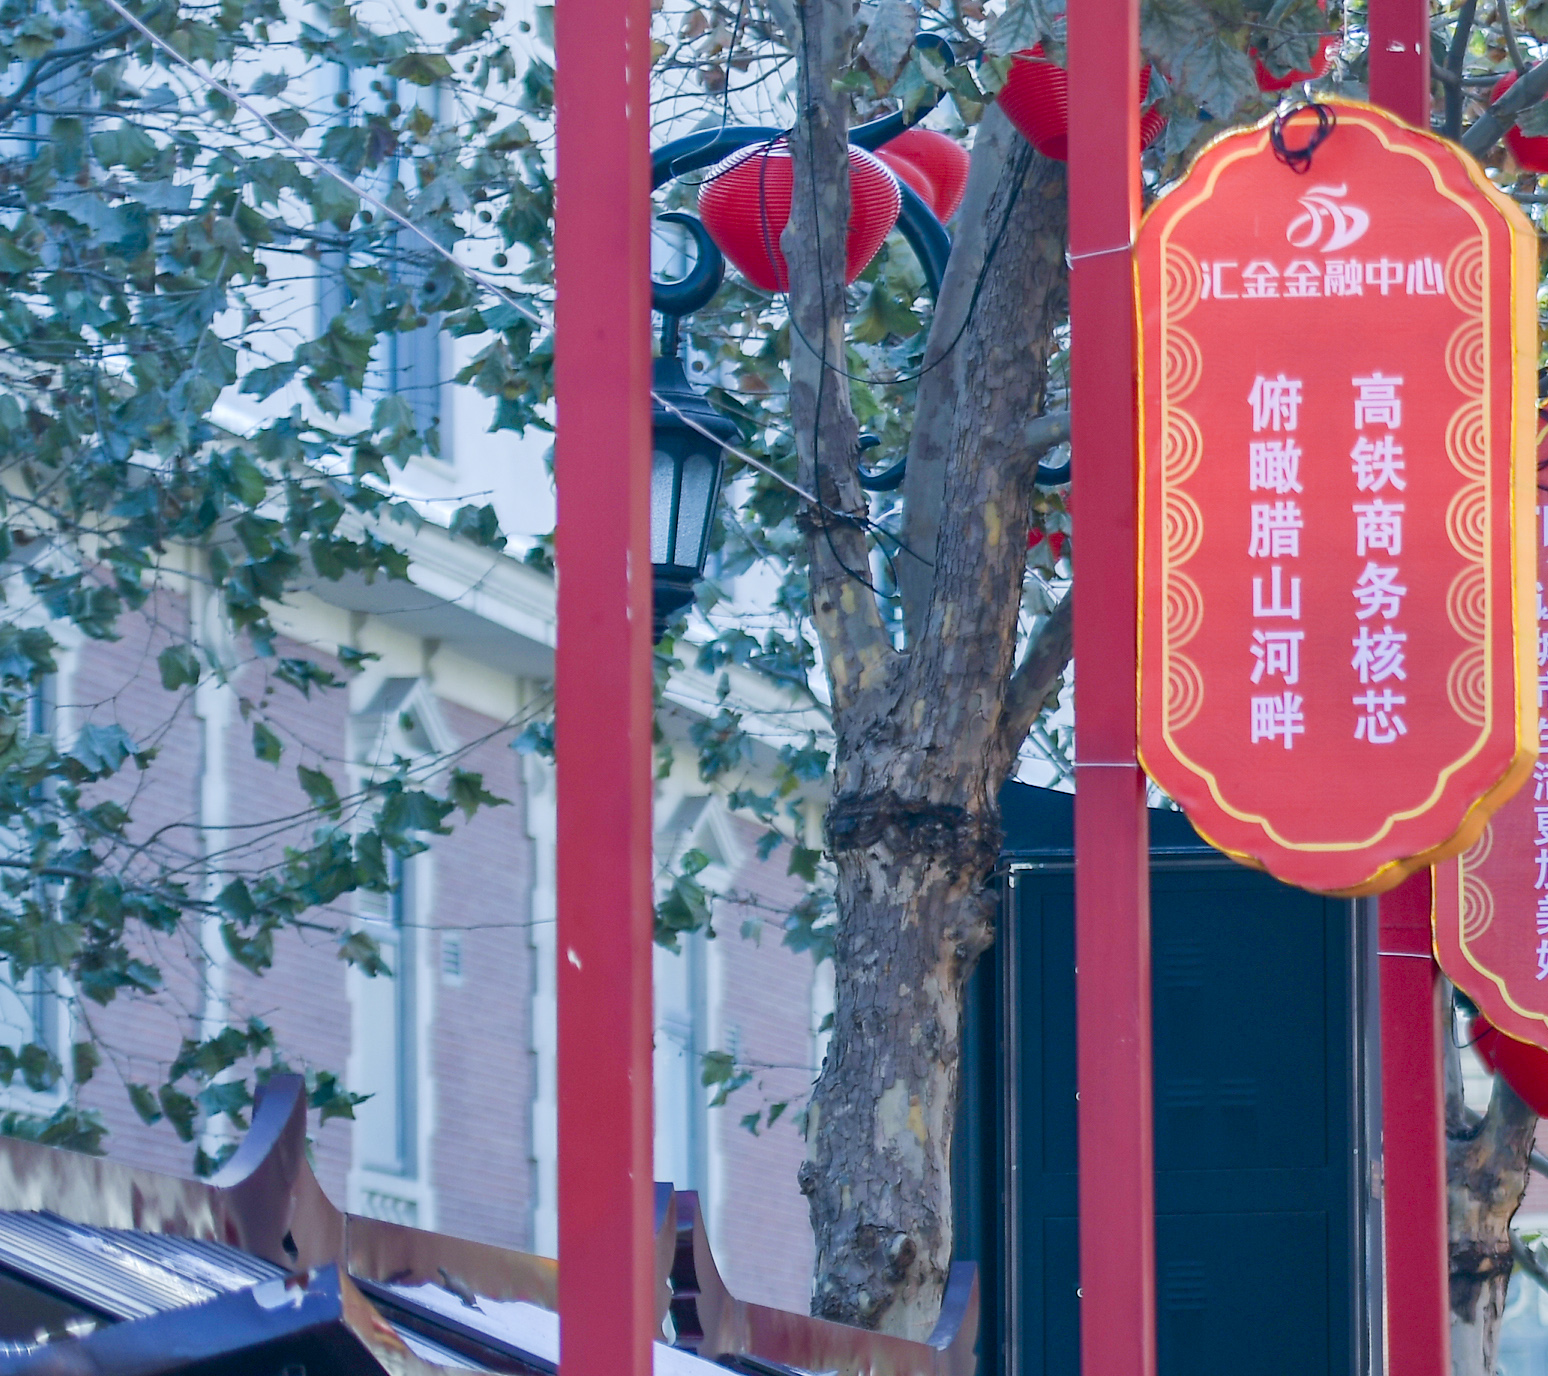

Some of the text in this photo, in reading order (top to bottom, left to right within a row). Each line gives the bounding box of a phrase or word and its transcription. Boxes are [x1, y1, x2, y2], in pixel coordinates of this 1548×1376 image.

[1195, 256, 1449, 300] 汇金金融中心
[1247, 373, 1306, 750] 俯瞰腊山河畔
[1349, 371, 1408, 744] 高铁商务核芯
